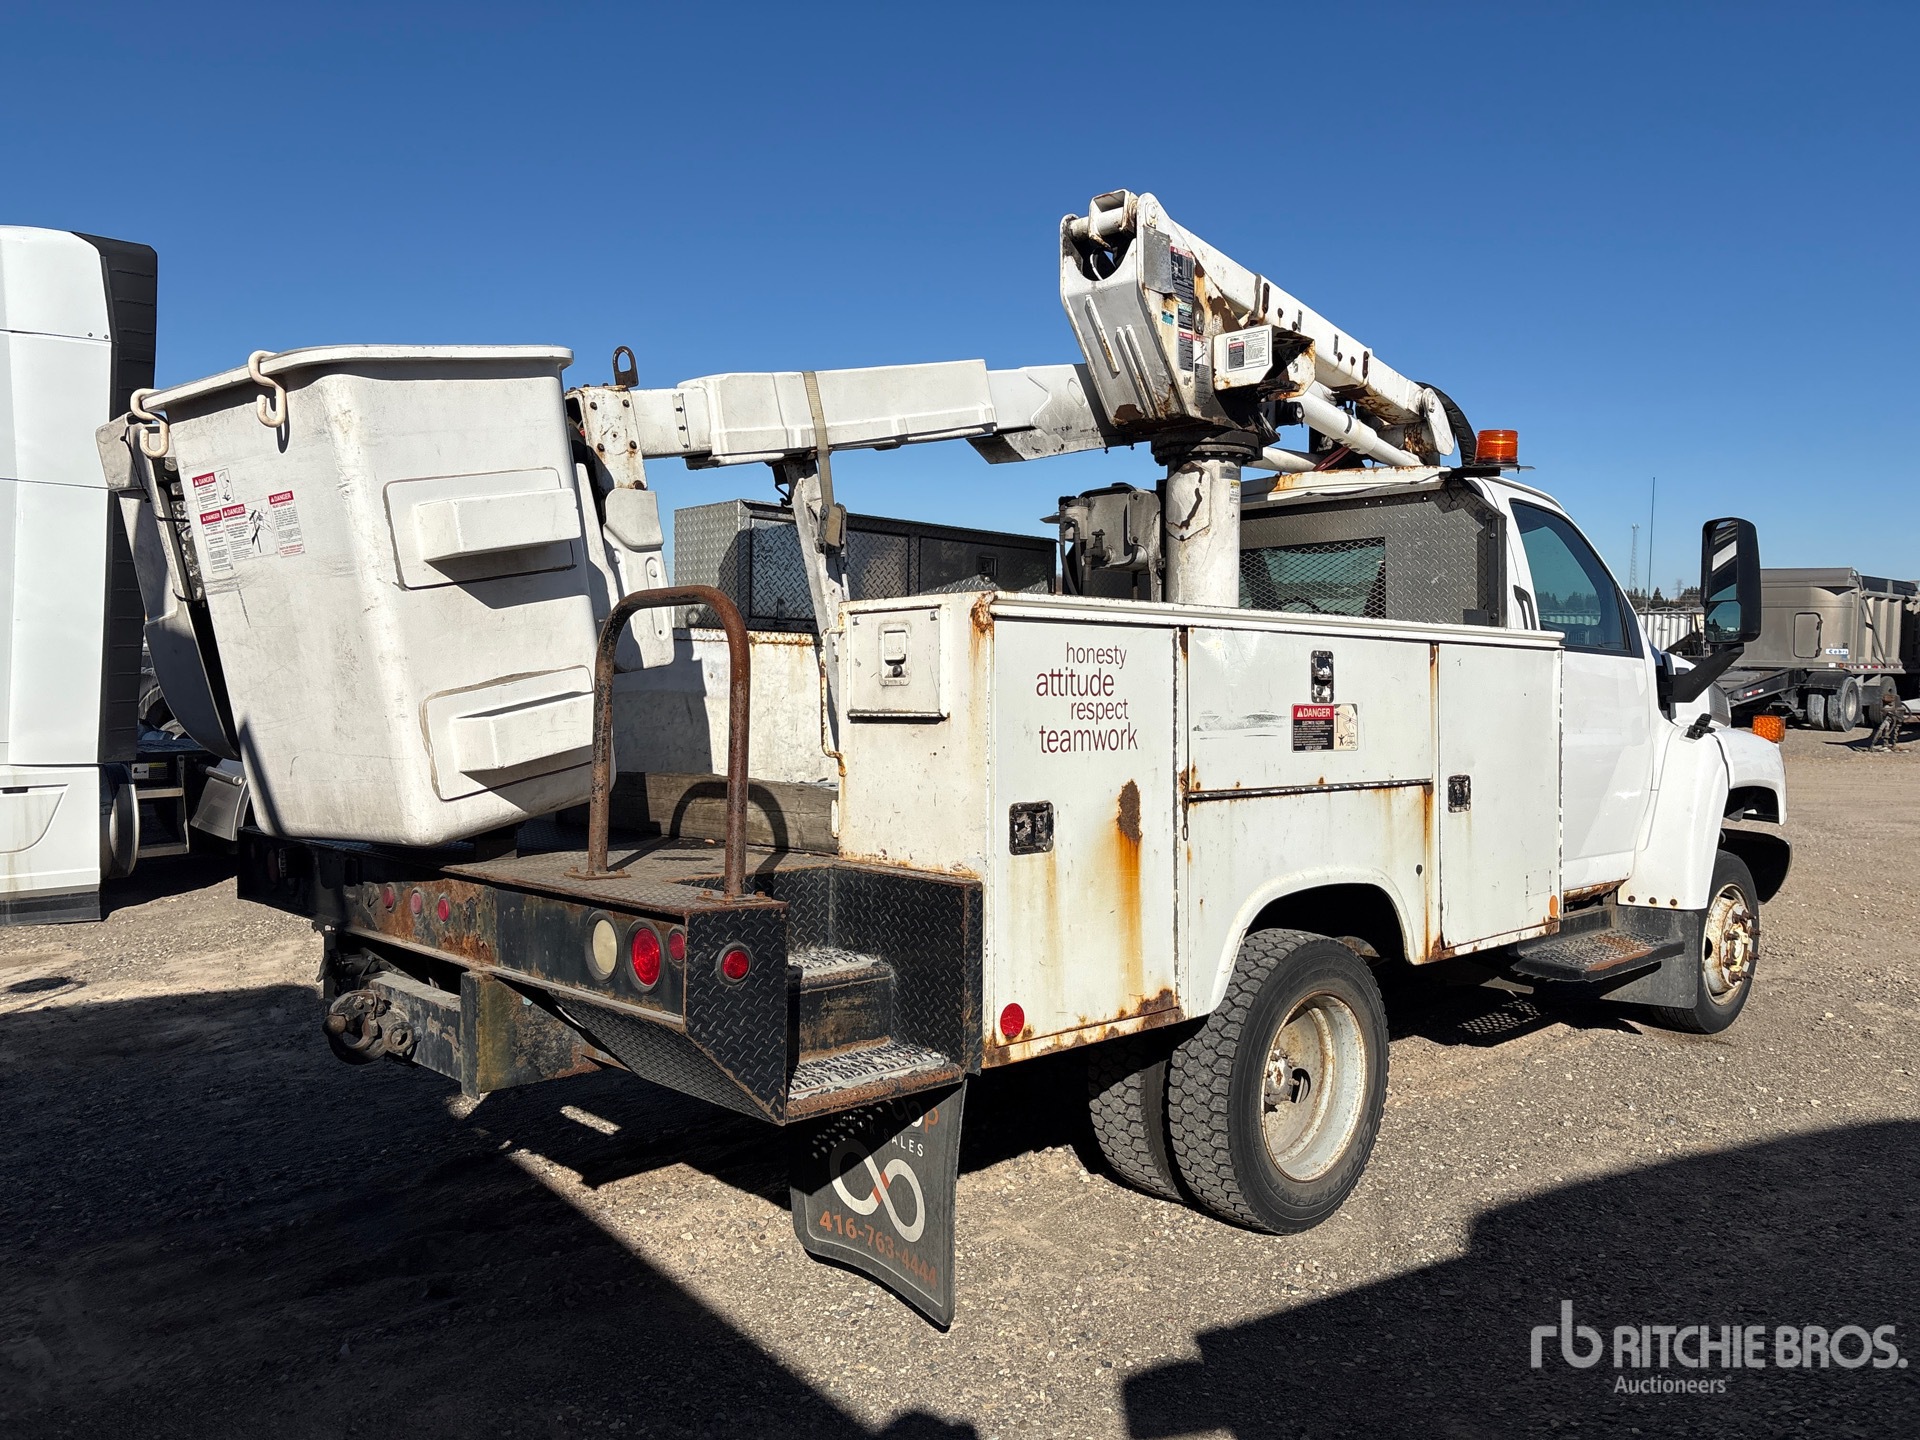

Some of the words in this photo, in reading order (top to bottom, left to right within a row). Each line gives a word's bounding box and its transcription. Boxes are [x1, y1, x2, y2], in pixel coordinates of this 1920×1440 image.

[198, 475, 214, 485] DANGER
[274, 493, 292, 502] DANGER
[205, 513, 220, 522] DANGER
[227, 506, 245, 516] DANGER
[1066, 641, 1127, 670] honesty
[1036, 666, 1114, 697] attitude
[1070, 698, 1129, 725] respect
[1303, 707, 1331, 717] DANGER
[1039, 721, 1138, 754] teamwork
[819, 1210, 938, 1290] 416-763-4444
